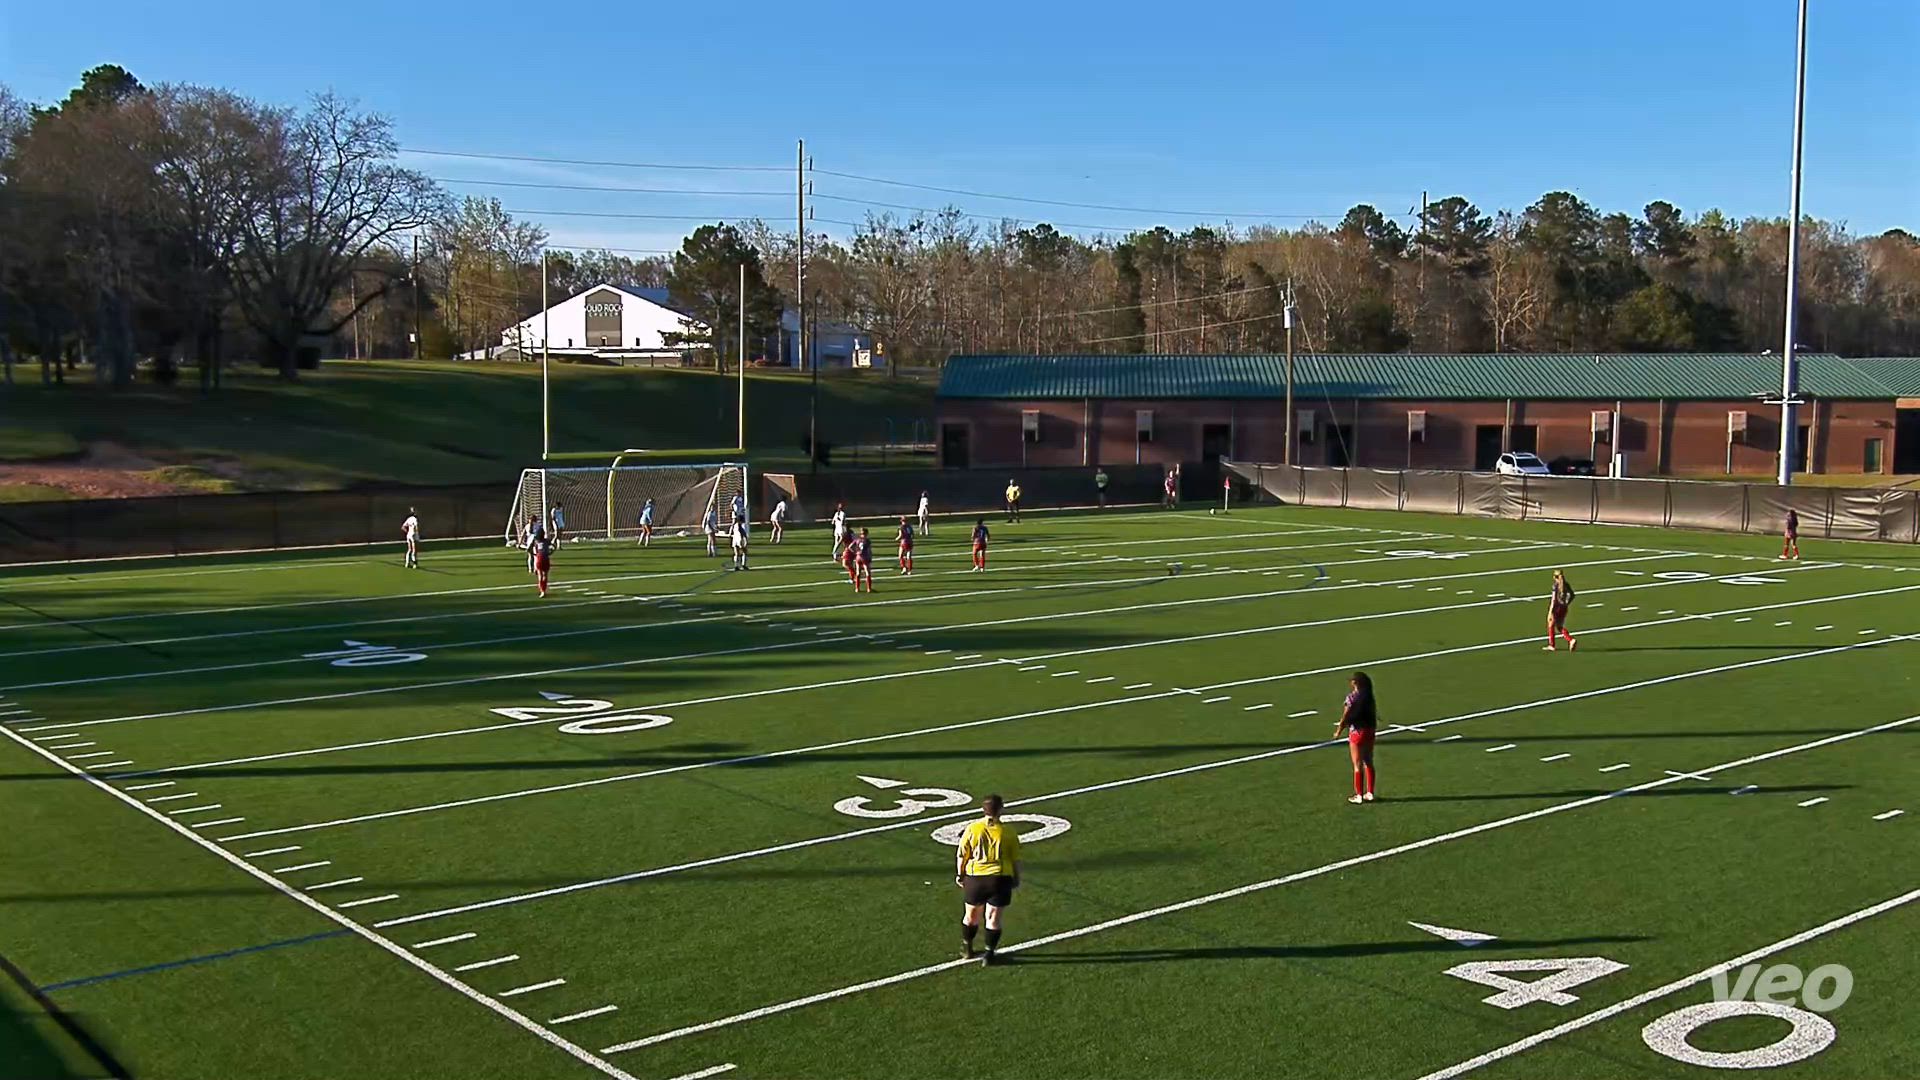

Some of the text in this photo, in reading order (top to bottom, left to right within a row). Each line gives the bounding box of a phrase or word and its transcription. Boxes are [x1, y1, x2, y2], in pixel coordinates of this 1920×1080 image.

[604, 303, 624, 312] ROCK
[489, 699, 674, 735] 20
[833, 787, 1072, 846] 30
[1442, 956, 1837, 1069] 40
